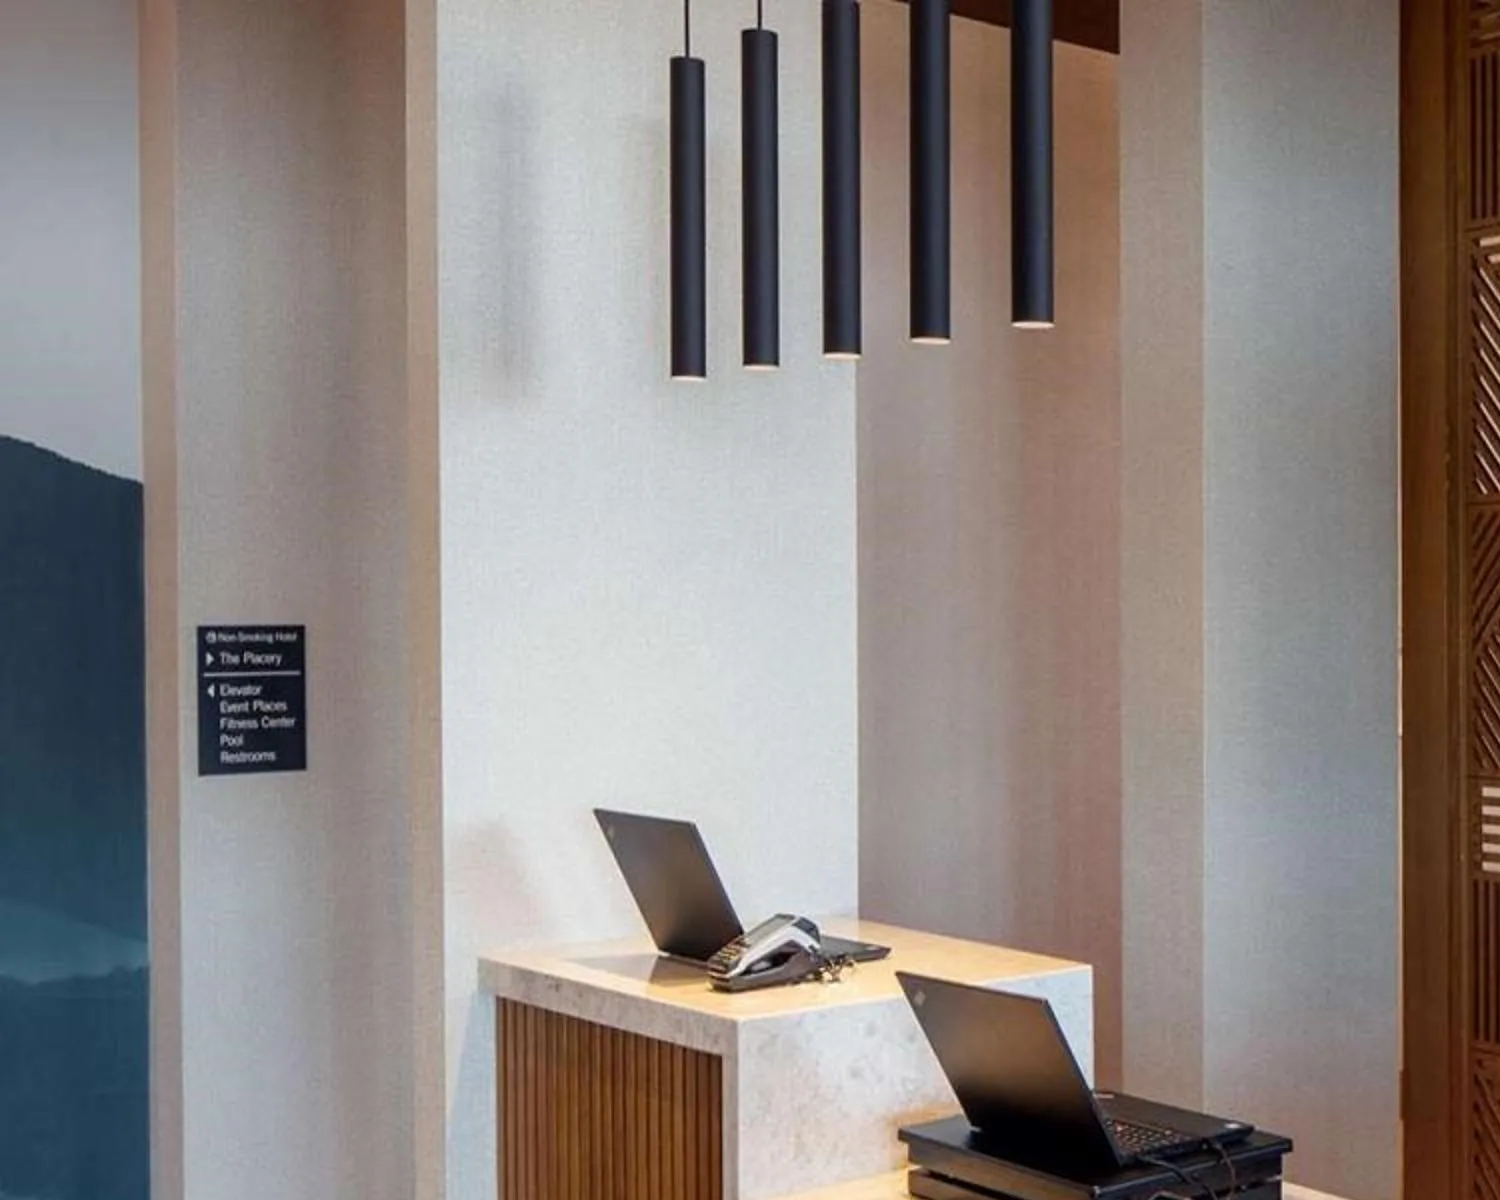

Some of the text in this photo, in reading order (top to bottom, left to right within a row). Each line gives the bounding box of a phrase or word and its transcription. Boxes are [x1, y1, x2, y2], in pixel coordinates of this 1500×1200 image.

[220, 651, 282, 666] The Placery
[220, 684, 262, 697] Elevator
[220, 700, 287, 713] Event Places
[220, 716, 295, 729] Fitness Center
[220, 734, 244, 746] Pool
[220, 751, 276, 763] Restrooms
